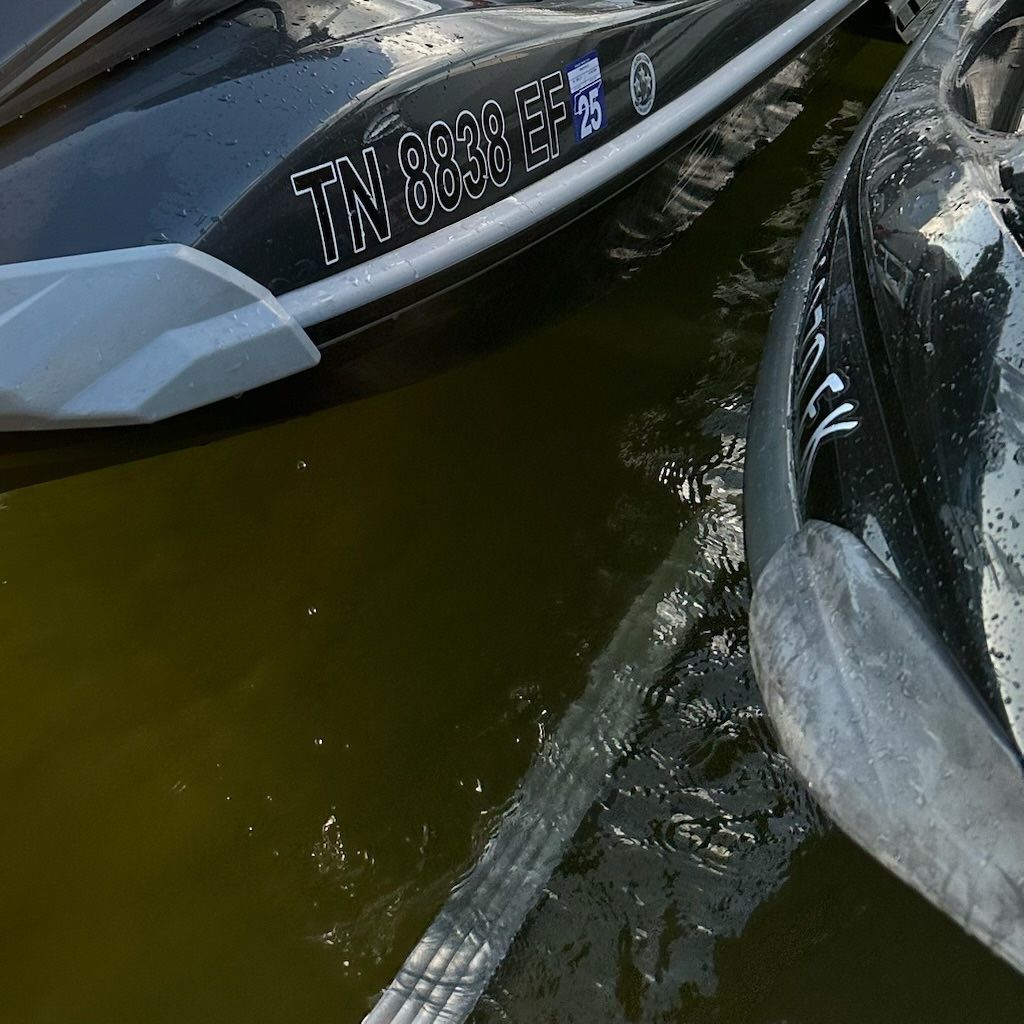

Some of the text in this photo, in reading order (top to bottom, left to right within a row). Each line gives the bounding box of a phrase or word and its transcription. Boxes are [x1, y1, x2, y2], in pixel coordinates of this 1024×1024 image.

[291, 70, 567, 266] TN 8838 EF
[578, 88, 602, 139] 25
